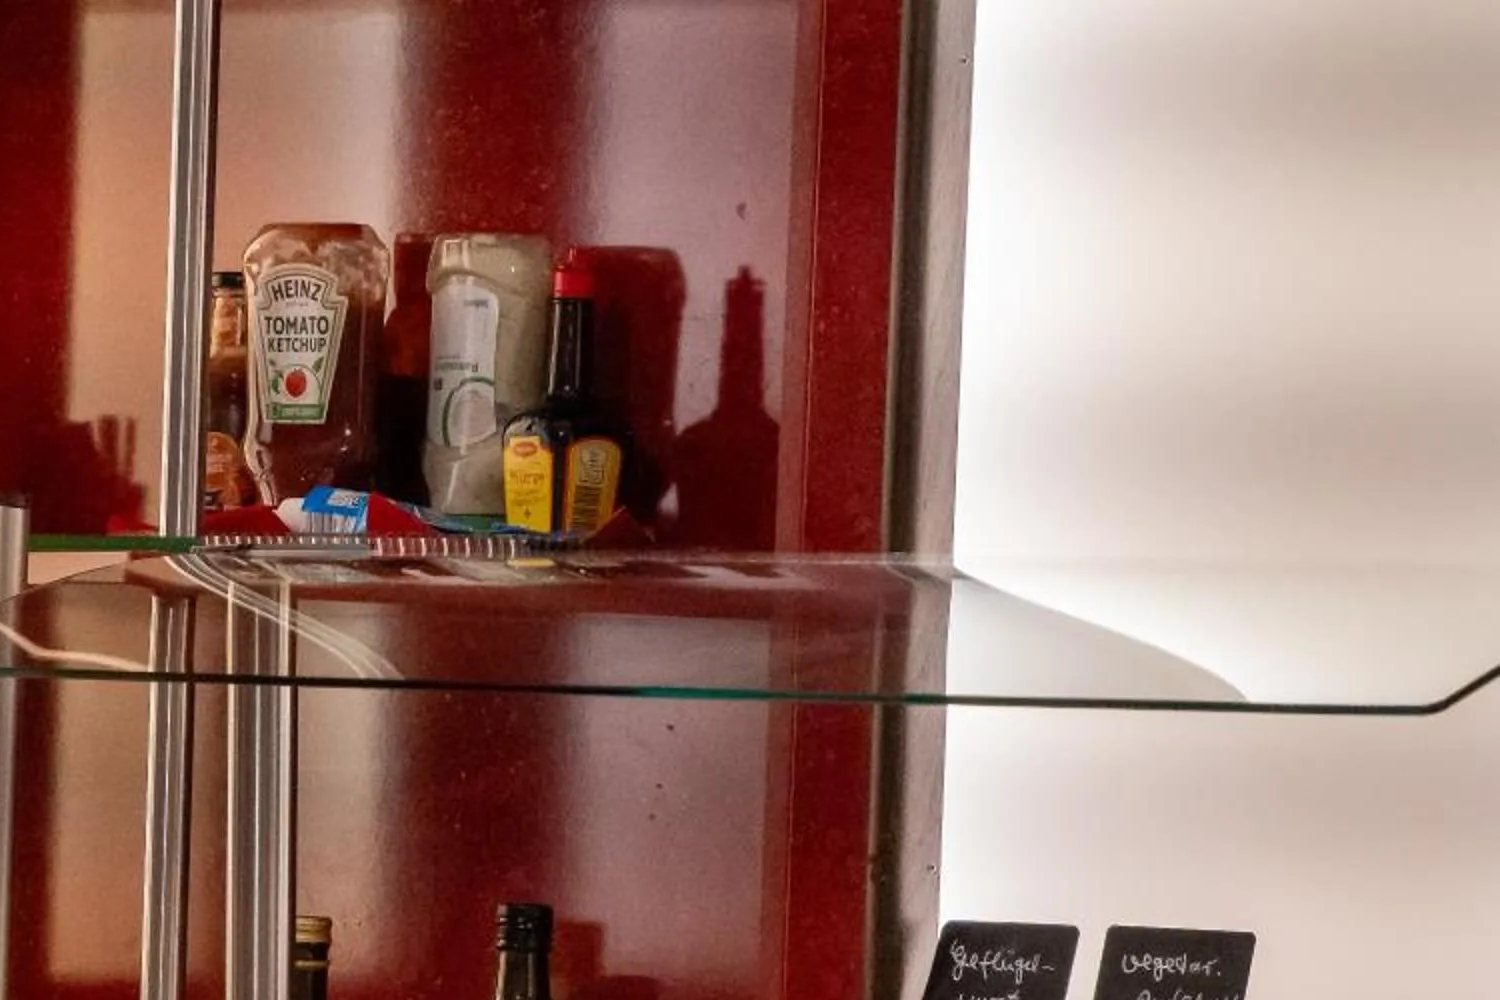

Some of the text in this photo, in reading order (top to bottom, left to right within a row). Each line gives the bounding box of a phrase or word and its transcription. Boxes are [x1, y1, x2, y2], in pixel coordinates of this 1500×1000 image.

[271, 279, 323, 302] HEINZ
[264, 315, 329, 335] TOMATO
[267, 337, 327, 353] KETCHUP
